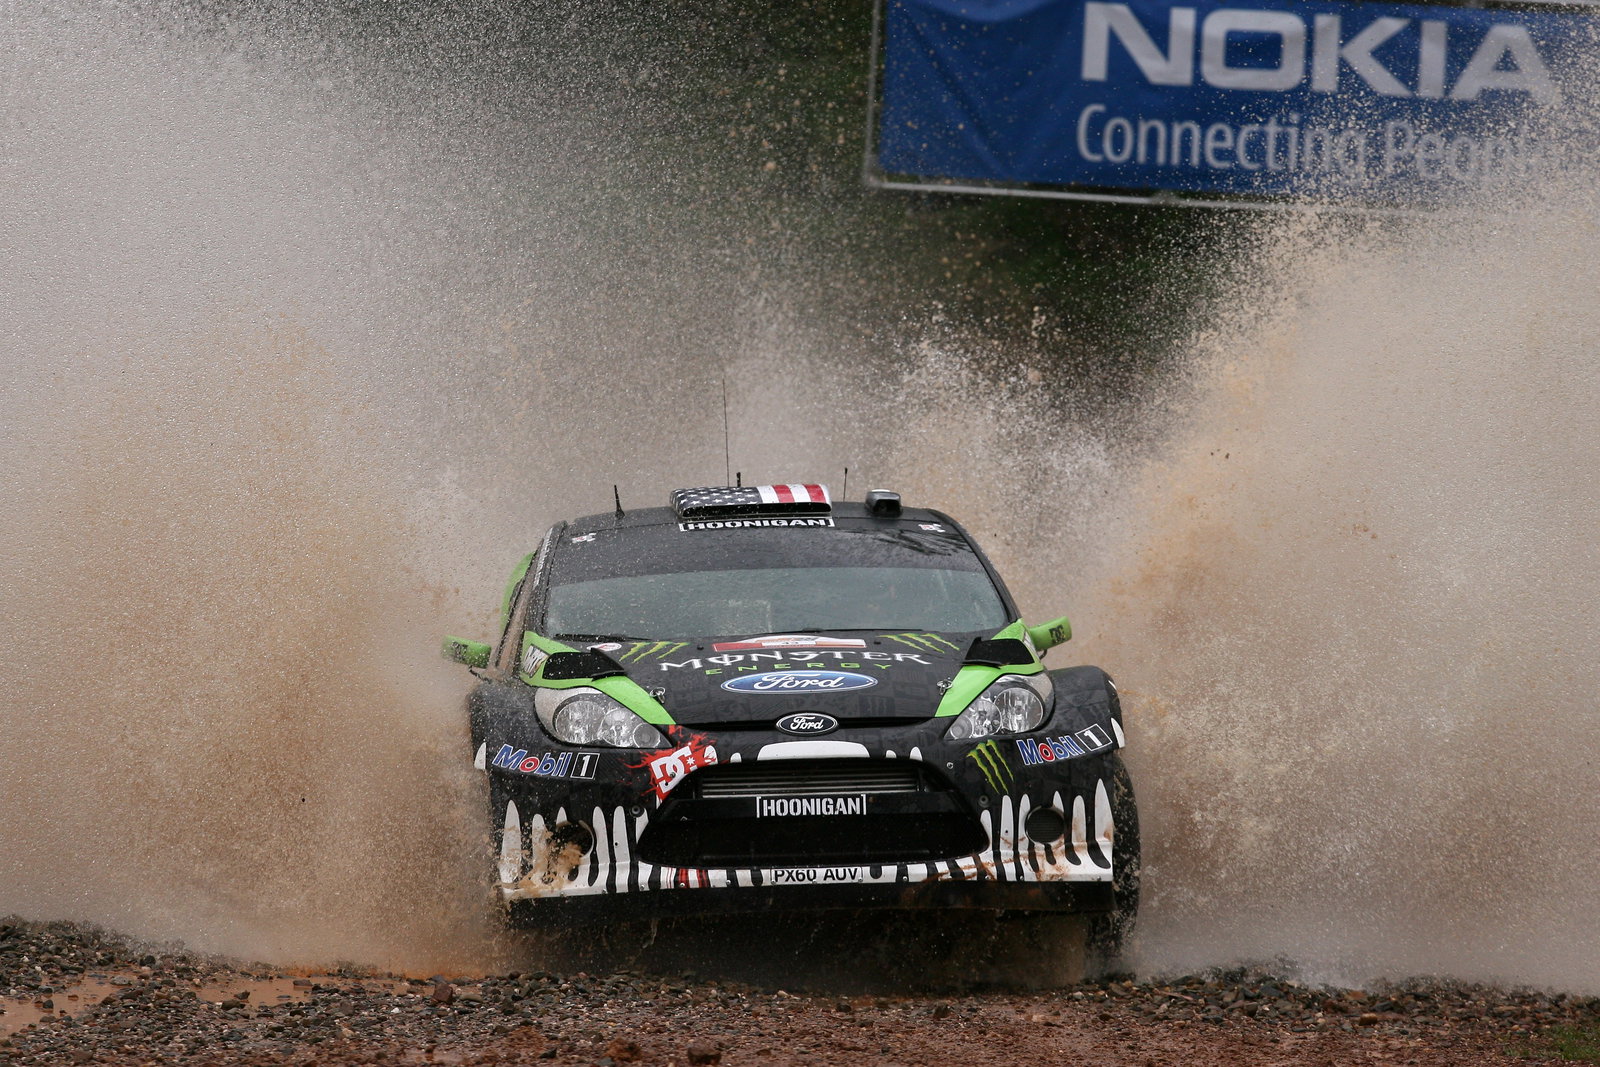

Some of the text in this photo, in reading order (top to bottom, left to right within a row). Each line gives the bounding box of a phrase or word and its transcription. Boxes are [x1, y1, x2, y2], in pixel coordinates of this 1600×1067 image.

[1081, 2, 1562, 103] NOKIA
[1076, 103, 1367, 188] Connecting
[705, 662, 892, 676] ENERGY
[753, 673, 845, 691] Ford
[789, 714, 825, 732] Ford
[492, 743, 572, 777] Mobil
[1016, 738, 1084, 765] Mobil
[774, 867, 858, 882] PX60 AUV
